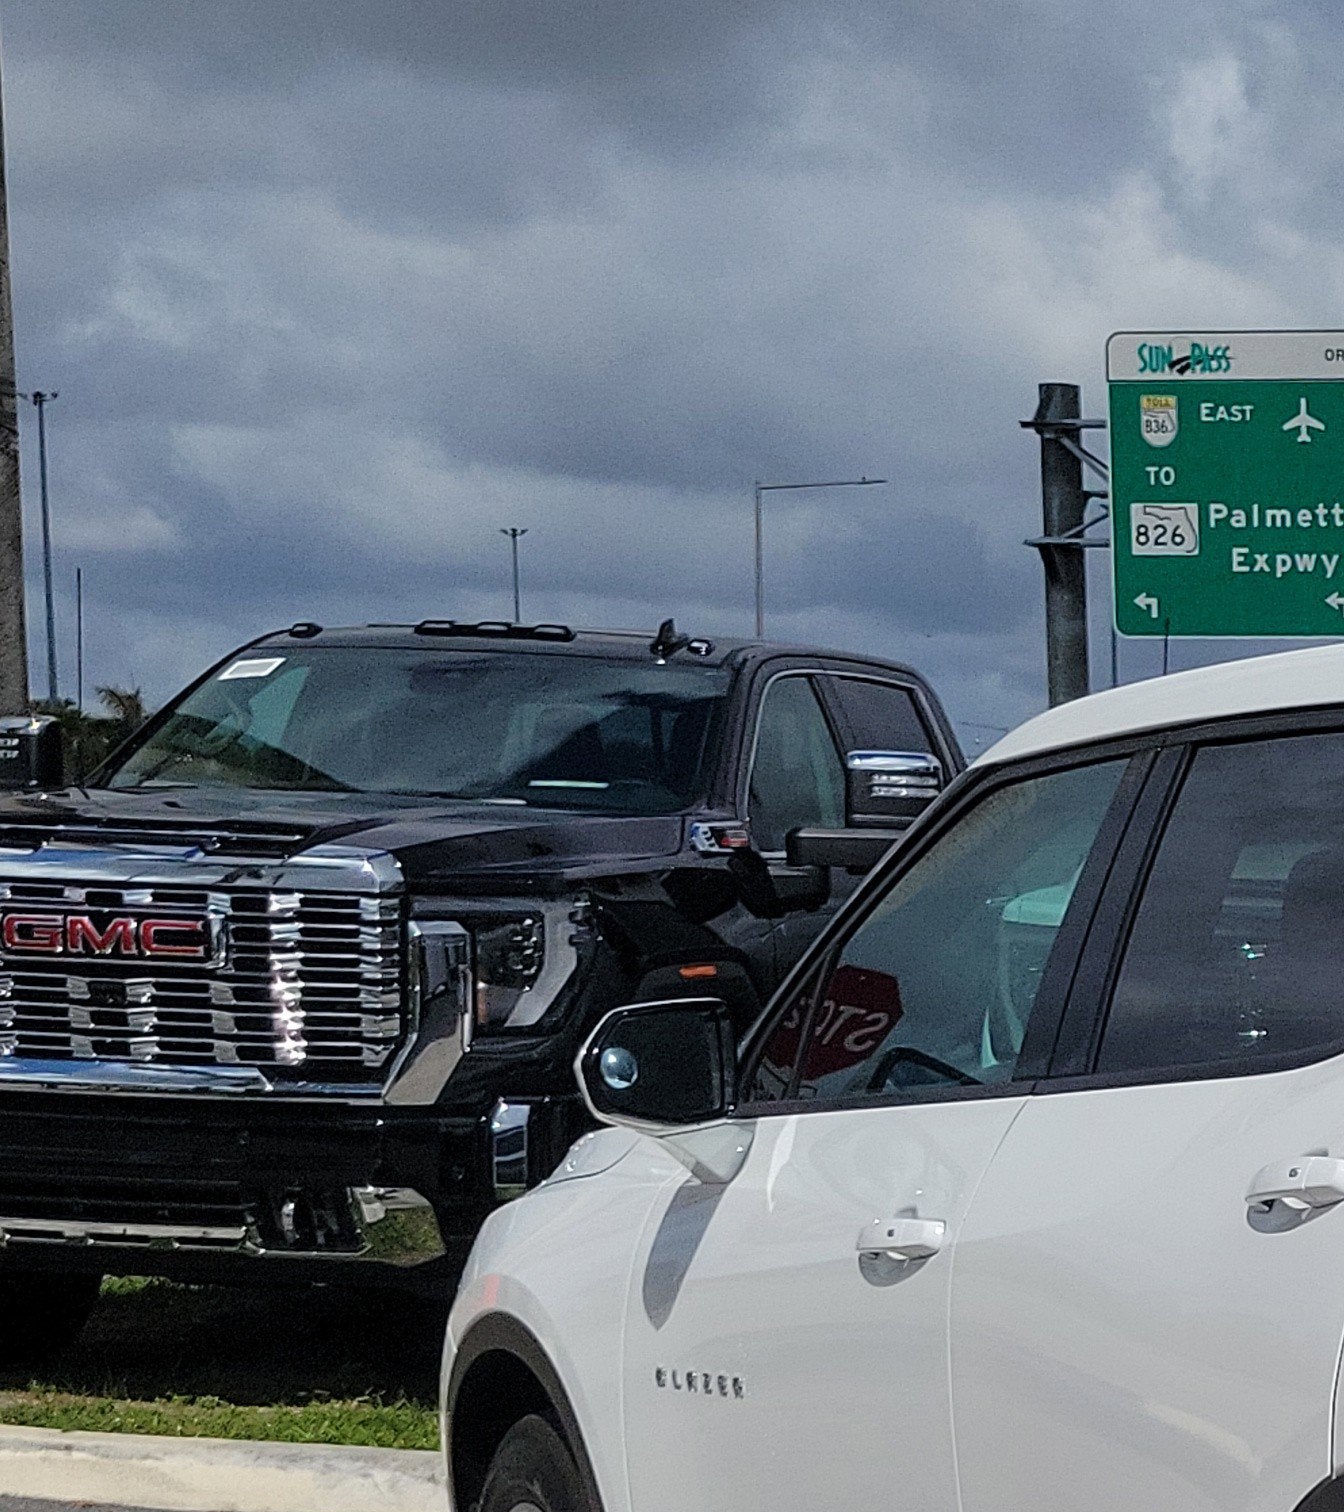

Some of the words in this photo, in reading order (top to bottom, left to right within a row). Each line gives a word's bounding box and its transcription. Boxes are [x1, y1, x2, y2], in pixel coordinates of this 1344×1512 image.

[1325, 348, 1344, 361] OR
[1200, 402, 1254, 422] EAST
[1145, 418, 1169, 434] 836
[1145, 466, 1175, 486] TO
[1135, 524, 1185, 546] 826
[1232, 547, 1340, 578] Expwy
[3, 913, 206, 957] GMC
[655, 1366, 744, 1399] BLAZER
